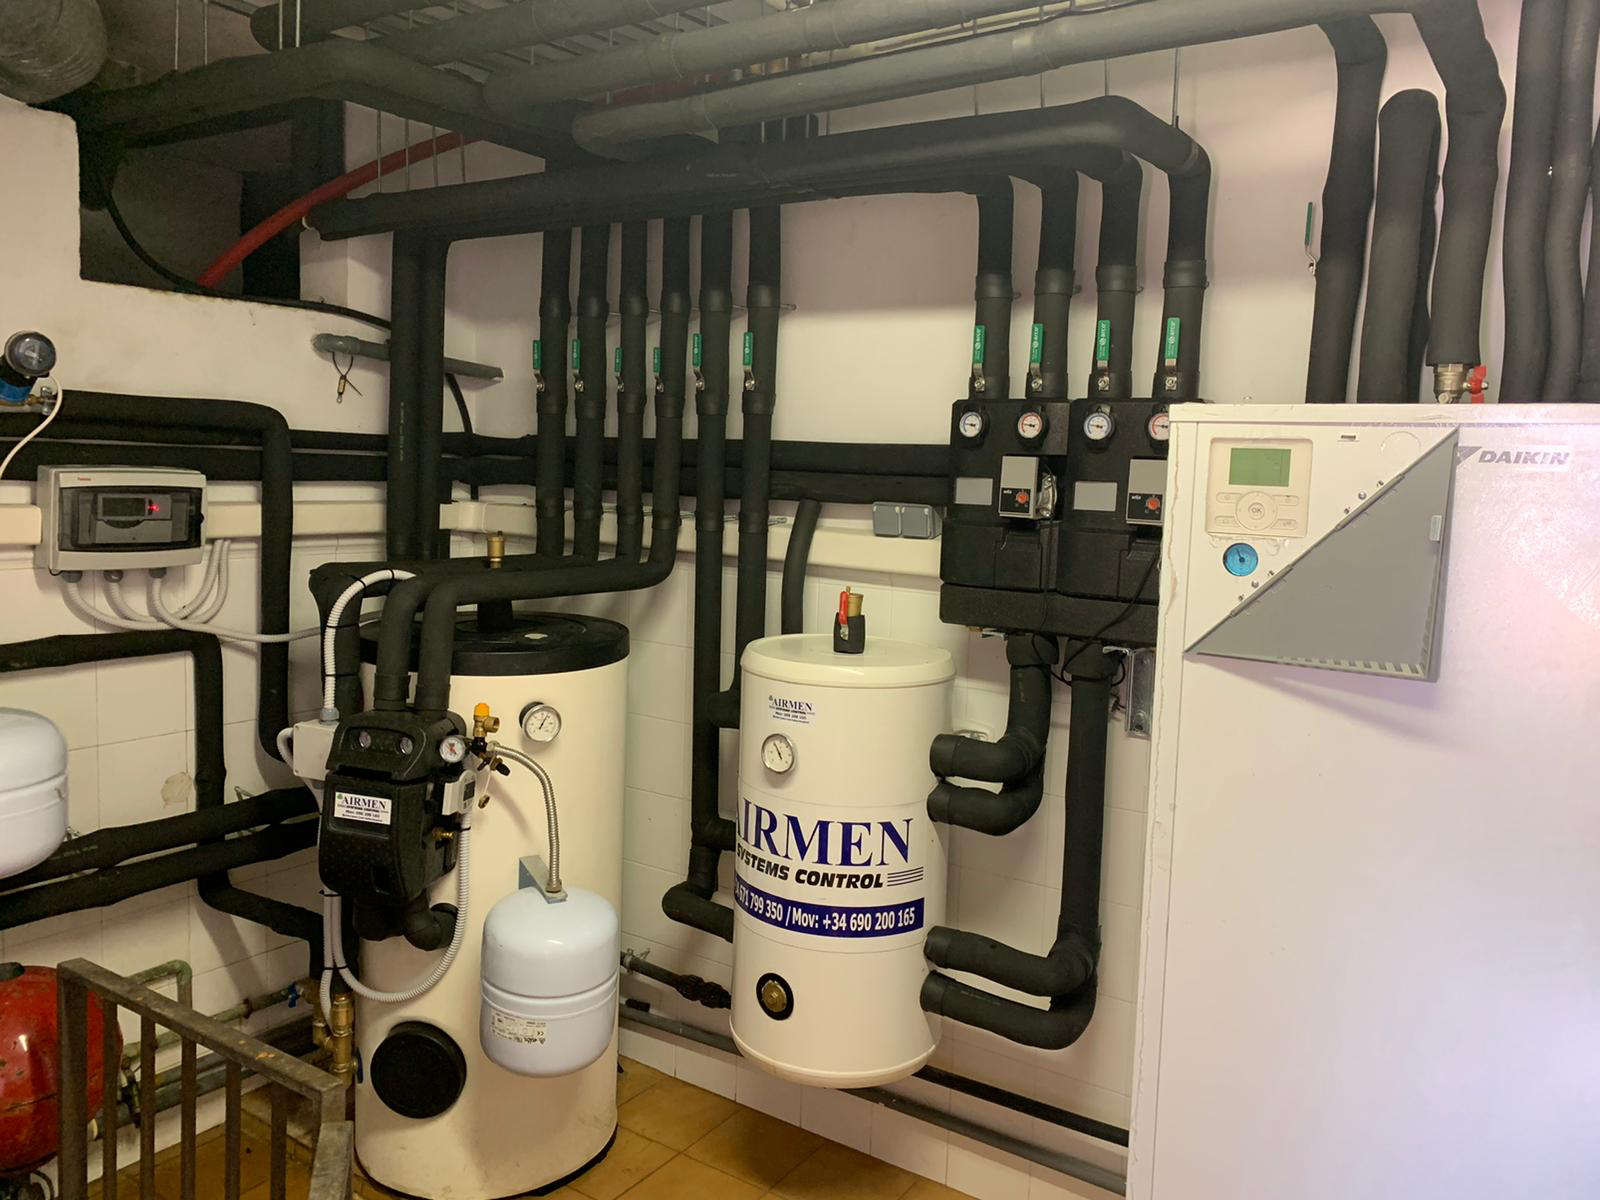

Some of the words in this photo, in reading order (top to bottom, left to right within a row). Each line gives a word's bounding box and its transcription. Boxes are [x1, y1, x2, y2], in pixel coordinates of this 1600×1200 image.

[1478, 450, 1570, 465] DAIKIN
[772, 698, 813, 711] AIRMEN
[342, 796, 386, 809] AIRMEN
[737, 844, 790, 881] SYSTEMS
[795, 869, 884, 889] CONTROL
[750, 892, 764, 915] 799
[765, 899, 783, 922] 350
[823, 912, 846, 931] +34
[850, 913, 872, 932] 690
[875, 911, 895, 931] 200
[898, 907, 916, 928] 165
